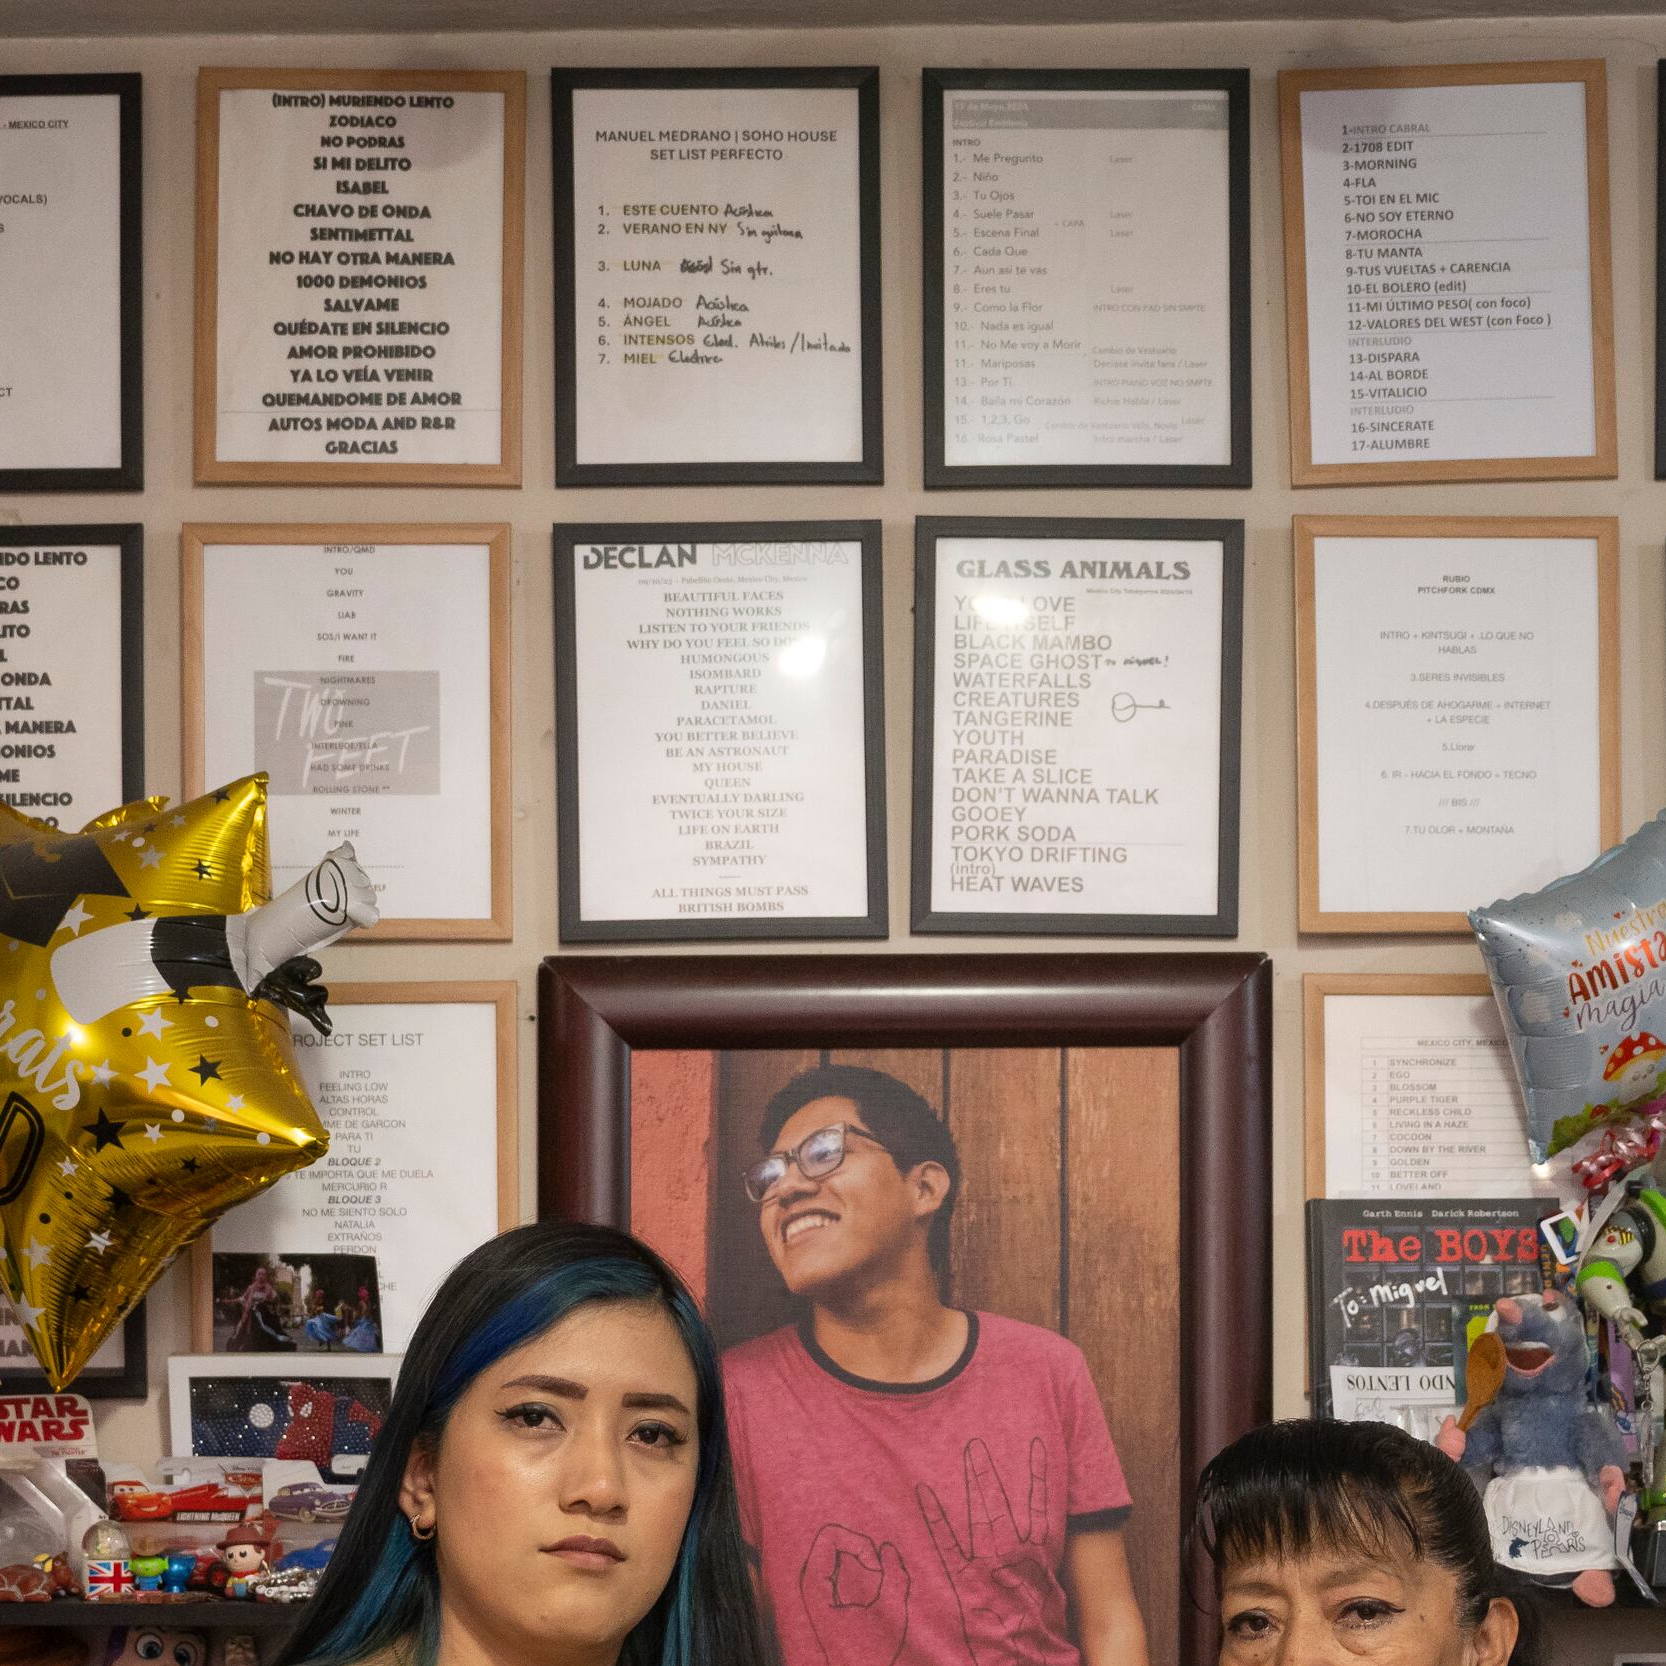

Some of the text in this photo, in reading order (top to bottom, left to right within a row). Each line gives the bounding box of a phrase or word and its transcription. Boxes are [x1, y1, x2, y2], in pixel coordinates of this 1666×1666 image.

[271, 92, 455, 109] (INTRO) MURIENDO LENTO
[328, 114, 397, 128] ZODIACO
[319, 135, 405, 149] NO PODRAS
[595, 129, 837, 142] MANUEL MEDRANO SOHO HOUSE
[649, 147, 783, 161] SET LIST PERFECTO
[1342, 158, 1417, 171] 3-MORNING
[335, 179, 389, 195] ISABEL
[1342, 177, 1377, 188] 4-FLA
[623, 259, 661, 271] LUNA
[323, 297, 399, 313] SALVAME
[1349, 351, 1421, 364] 13-DISPARA
[324, 440, 399, 455] GRACIAS
[583, 543, 849, 571] DECLAN MCKENNA
[955, 559, 1192, 581] GLASS ANIMALS
[1442, 575, 1471, 583] RUBIO
[325, 588, 364, 597] GRAVITY
[663, 591, 784, 602] BEAUTIFUL FACES
[1417, 586, 1495, 595] PITCHFORK CDMX
[953, 633, 1113, 651] BLACK MAMBO
[952, 671, 1091, 689] WATERFALLS
[700, 699, 751, 710] DANIEL
[952, 690, 1080, 708] CREATURES
[951, 710, 1073, 727] TANGERINE
[952, 748, 1057, 765] PARADISE
[703, 777, 751, 790] QUEEN
[329, 806, 361, 815] WINTER
[951, 874, 1084, 893] HEAT WAVES
[1576, 979, 1666, 1032] magia
[358, 1032, 424, 1048] SET LIST
[327, 1157, 381, 1167] BLOQUE 2
[1363, 1209, 1519, 1218] Garth Ennis Darick Robertson
[1342, 1228, 1538, 1263] The BOYS
[1333, 1267, 1448, 1328] To: Miguel
[1347, 1374, 1410, 1391] LENTOS
